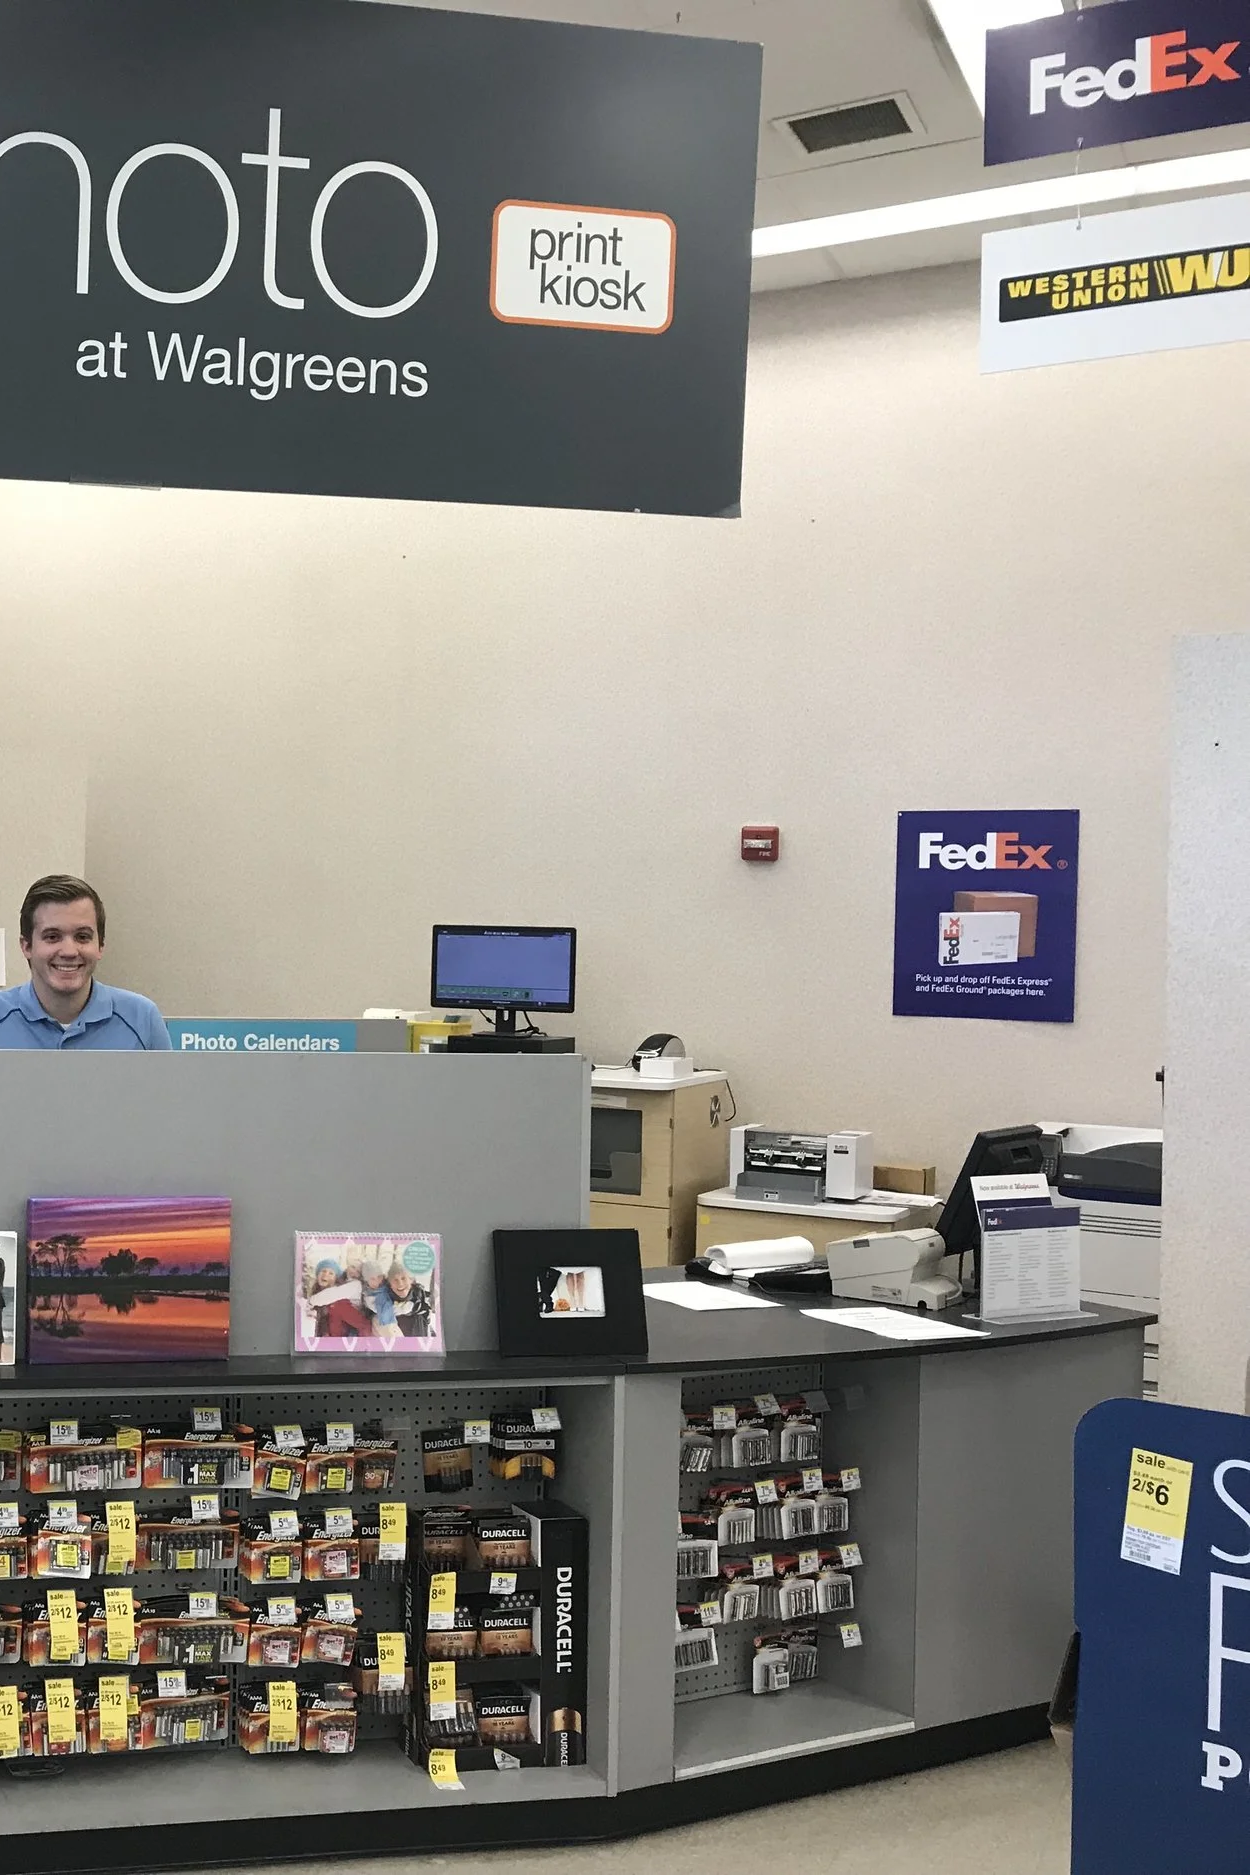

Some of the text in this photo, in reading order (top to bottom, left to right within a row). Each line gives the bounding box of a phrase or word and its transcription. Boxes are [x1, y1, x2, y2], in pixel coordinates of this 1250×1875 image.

[1029, 30, 1242, 116] FedEx
[528, 221, 624, 276] print
[539, 262, 647, 314] kiosk
[1007, 262, 1149, 298] WESTERN
[1052, 280, 1149, 310] UNION
[76, 332, 430, 400] at Walgreens
[918, 832, 1053, 870] FedEx
[943, 917, 961, 965] FedEx
[915, 974, 931, 983] Pick
[933, 975, 943, 984] up
[944, 974, 959, 983] and
[960, 974, 978, 985] drop
[979, 974, 990, 984] off
[992, 975, 1015, 985] FedEx
[915, 984, 929, 993] and
[931, 984, 955, 994] FedEx
[988, 986, 1025, 996] packages
[1026, 987, 1046, 996] here.
[181, 1033, 340, 1051] Photo Calendars
[738, 1418, 764, 1426] Alkaline
[184, 1432, 217, 1441] Energizer
[354, 1438, 393, 1449] Energizer
[425, 1438, 463, 1449] DURACEL
[523, 1440, 532, 1448] 10
[263, 1441, 304, 1457] Energizer
[1136, 1453, 1166, 1469] sale
[1132, 1478, 1170, 1506] 2/$6
[724, 1498, 751, 1506] Alkaline
[482, 1529, 527, 1538] DURACELL
[484, 1618, 528, 1627] DURACELL
[556, 1566, 573, 1673] DURACELL
[481, 1705, 525, 1715] DURACELL
